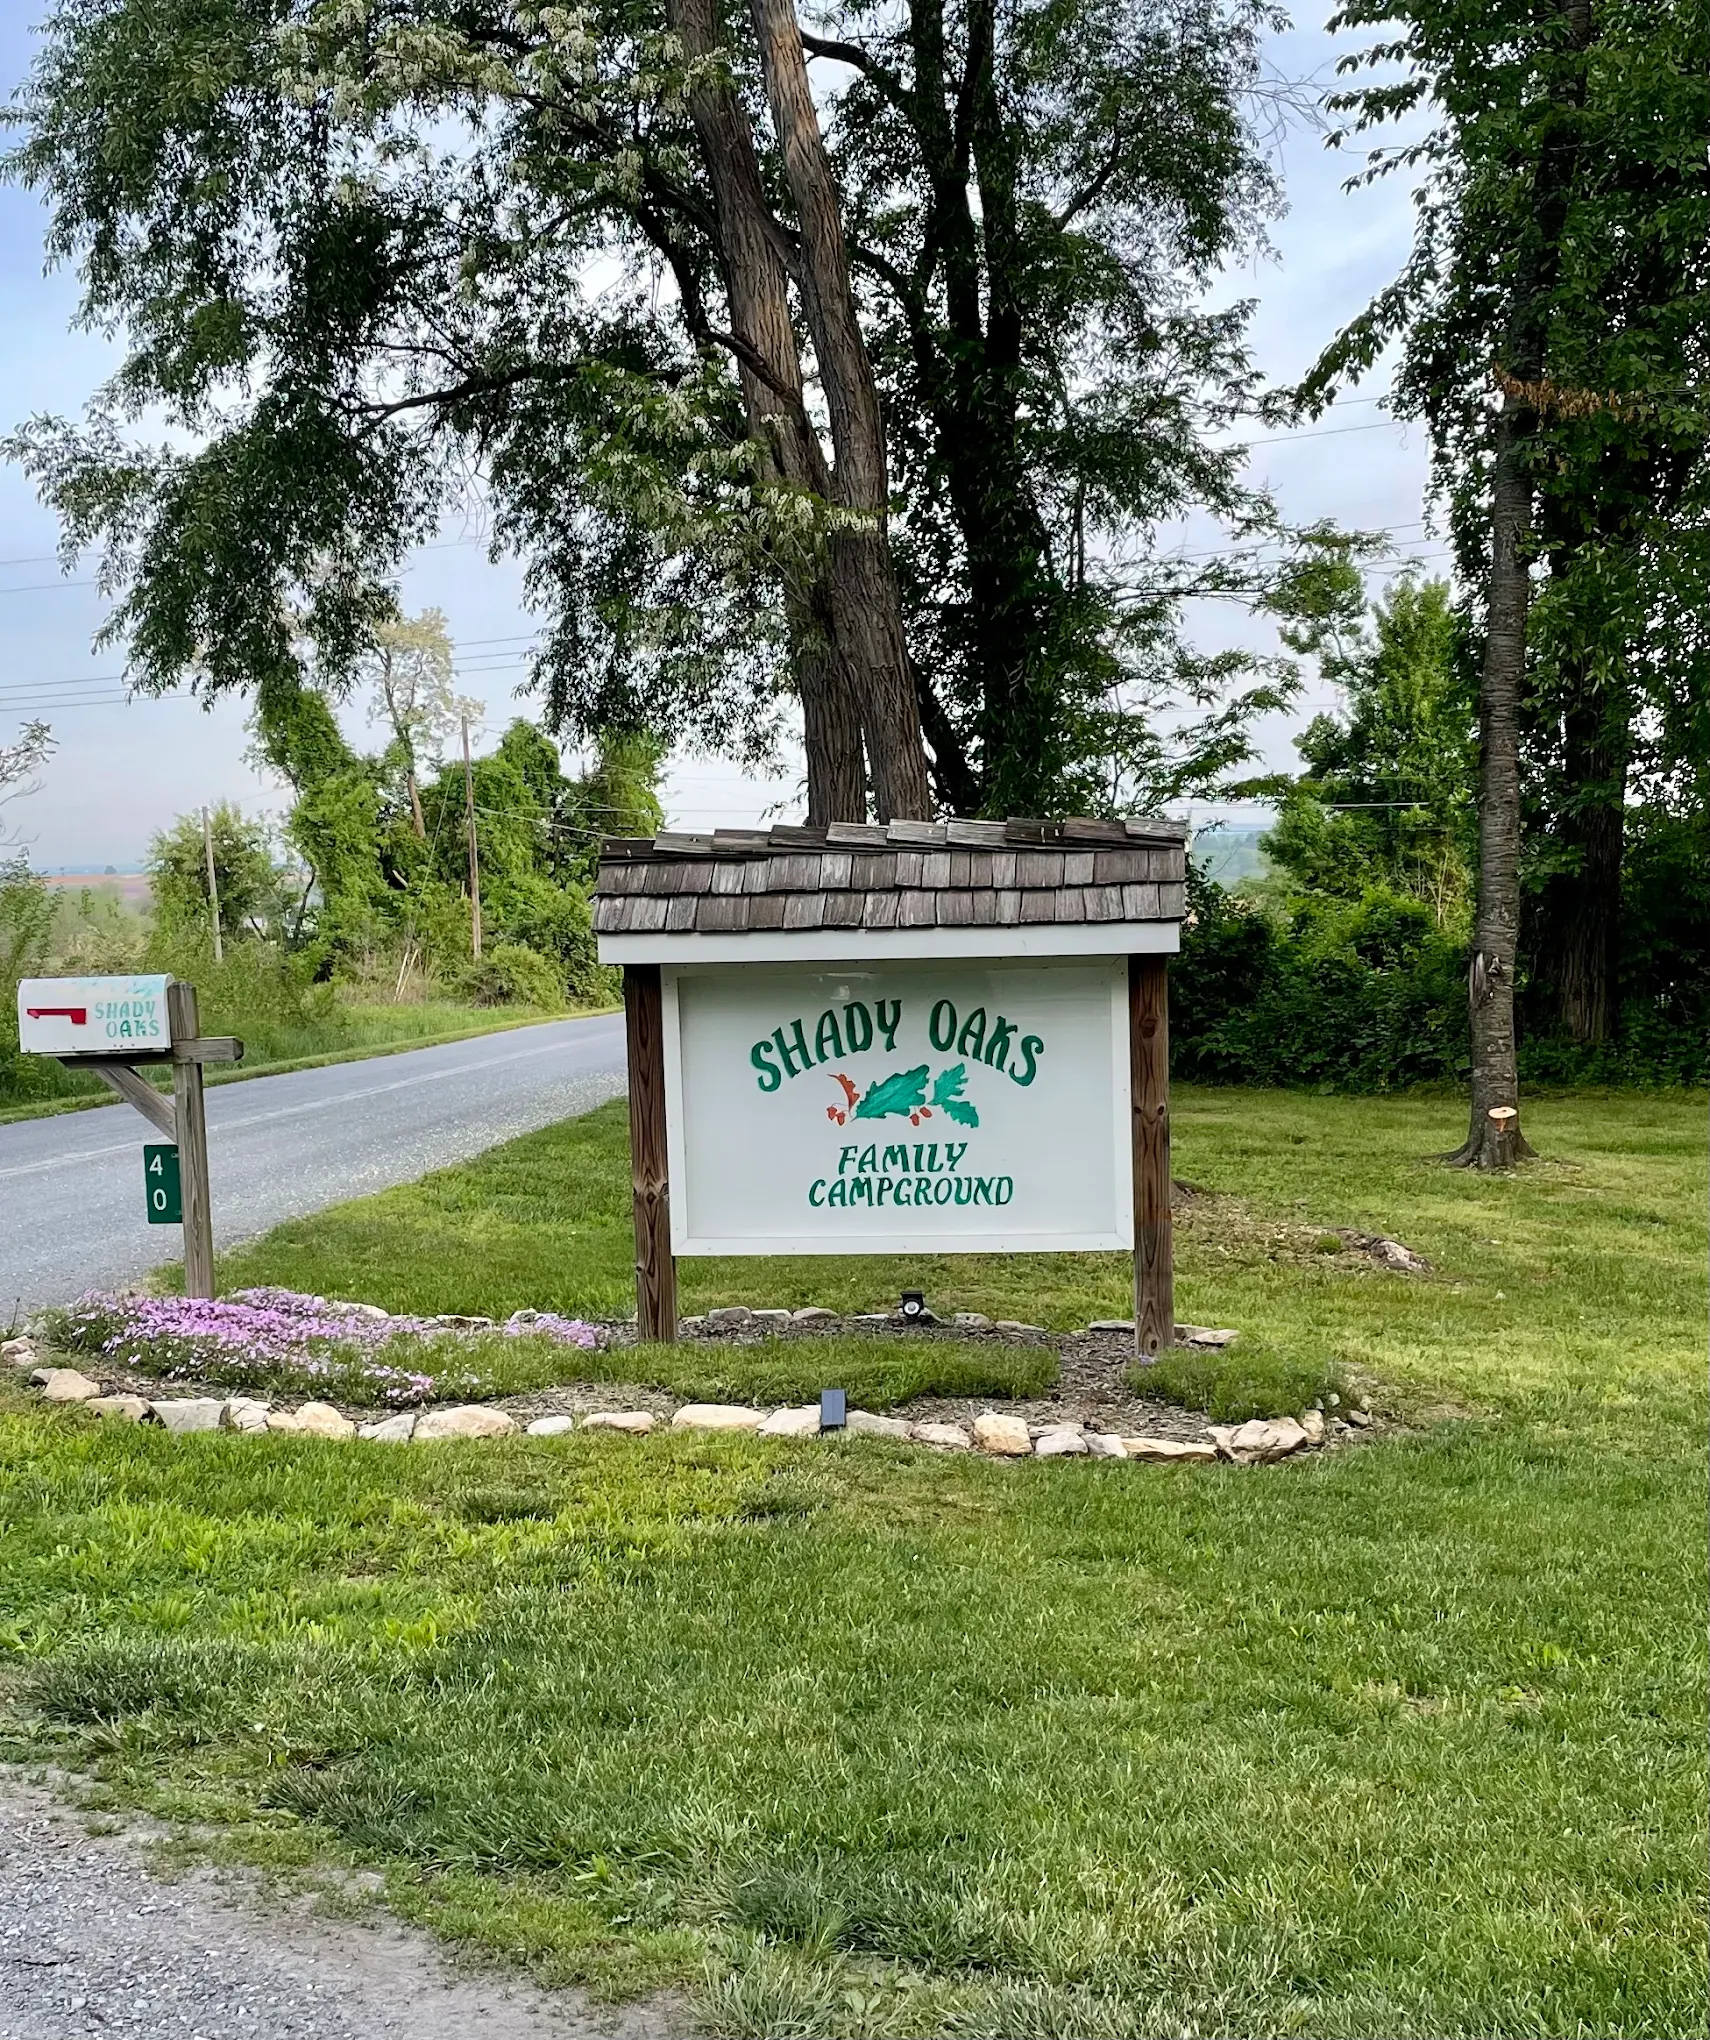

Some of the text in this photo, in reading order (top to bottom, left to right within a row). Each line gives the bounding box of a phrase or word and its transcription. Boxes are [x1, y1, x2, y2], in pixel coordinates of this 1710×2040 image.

[95, 1001, 156, 1019] SHADY
[106, 1019, 160, 1038] OAKS
[750, 999, 1045, 1092] SHADY OAKS
[838, 1142, 968, 1174] FAMILY
[808, 1176, 1013, 1207] CAMPGROUND
